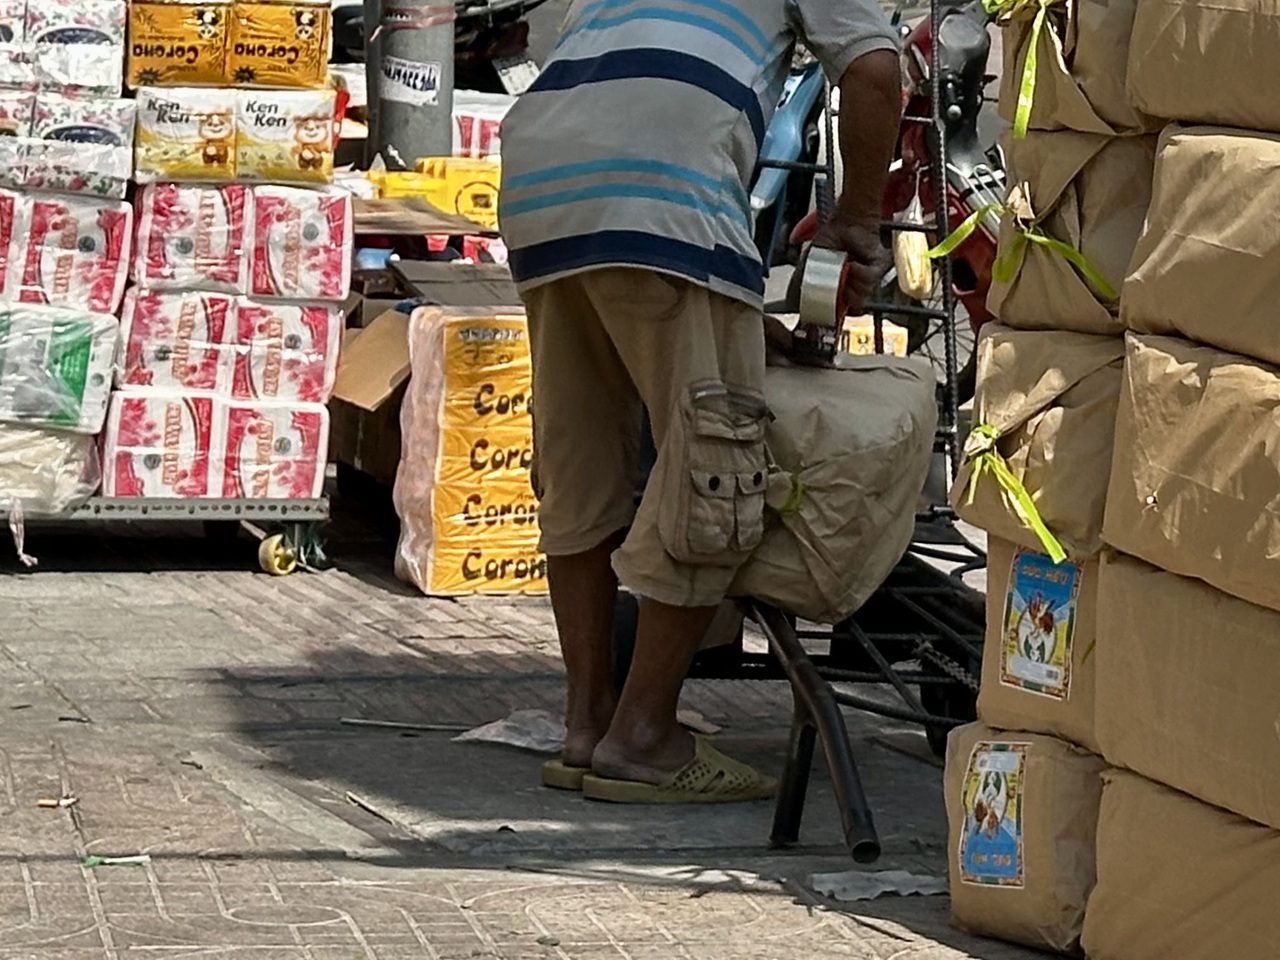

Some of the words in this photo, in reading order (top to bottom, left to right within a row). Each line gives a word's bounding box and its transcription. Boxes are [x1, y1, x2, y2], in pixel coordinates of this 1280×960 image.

[132, 44, 198, 64] Corona
[234, 43, 299, 64] Corona
[246, 101, 279, 114] Ken
[254, 114, 287, 127] Ken
[462, 548, 548, 580] Coron
